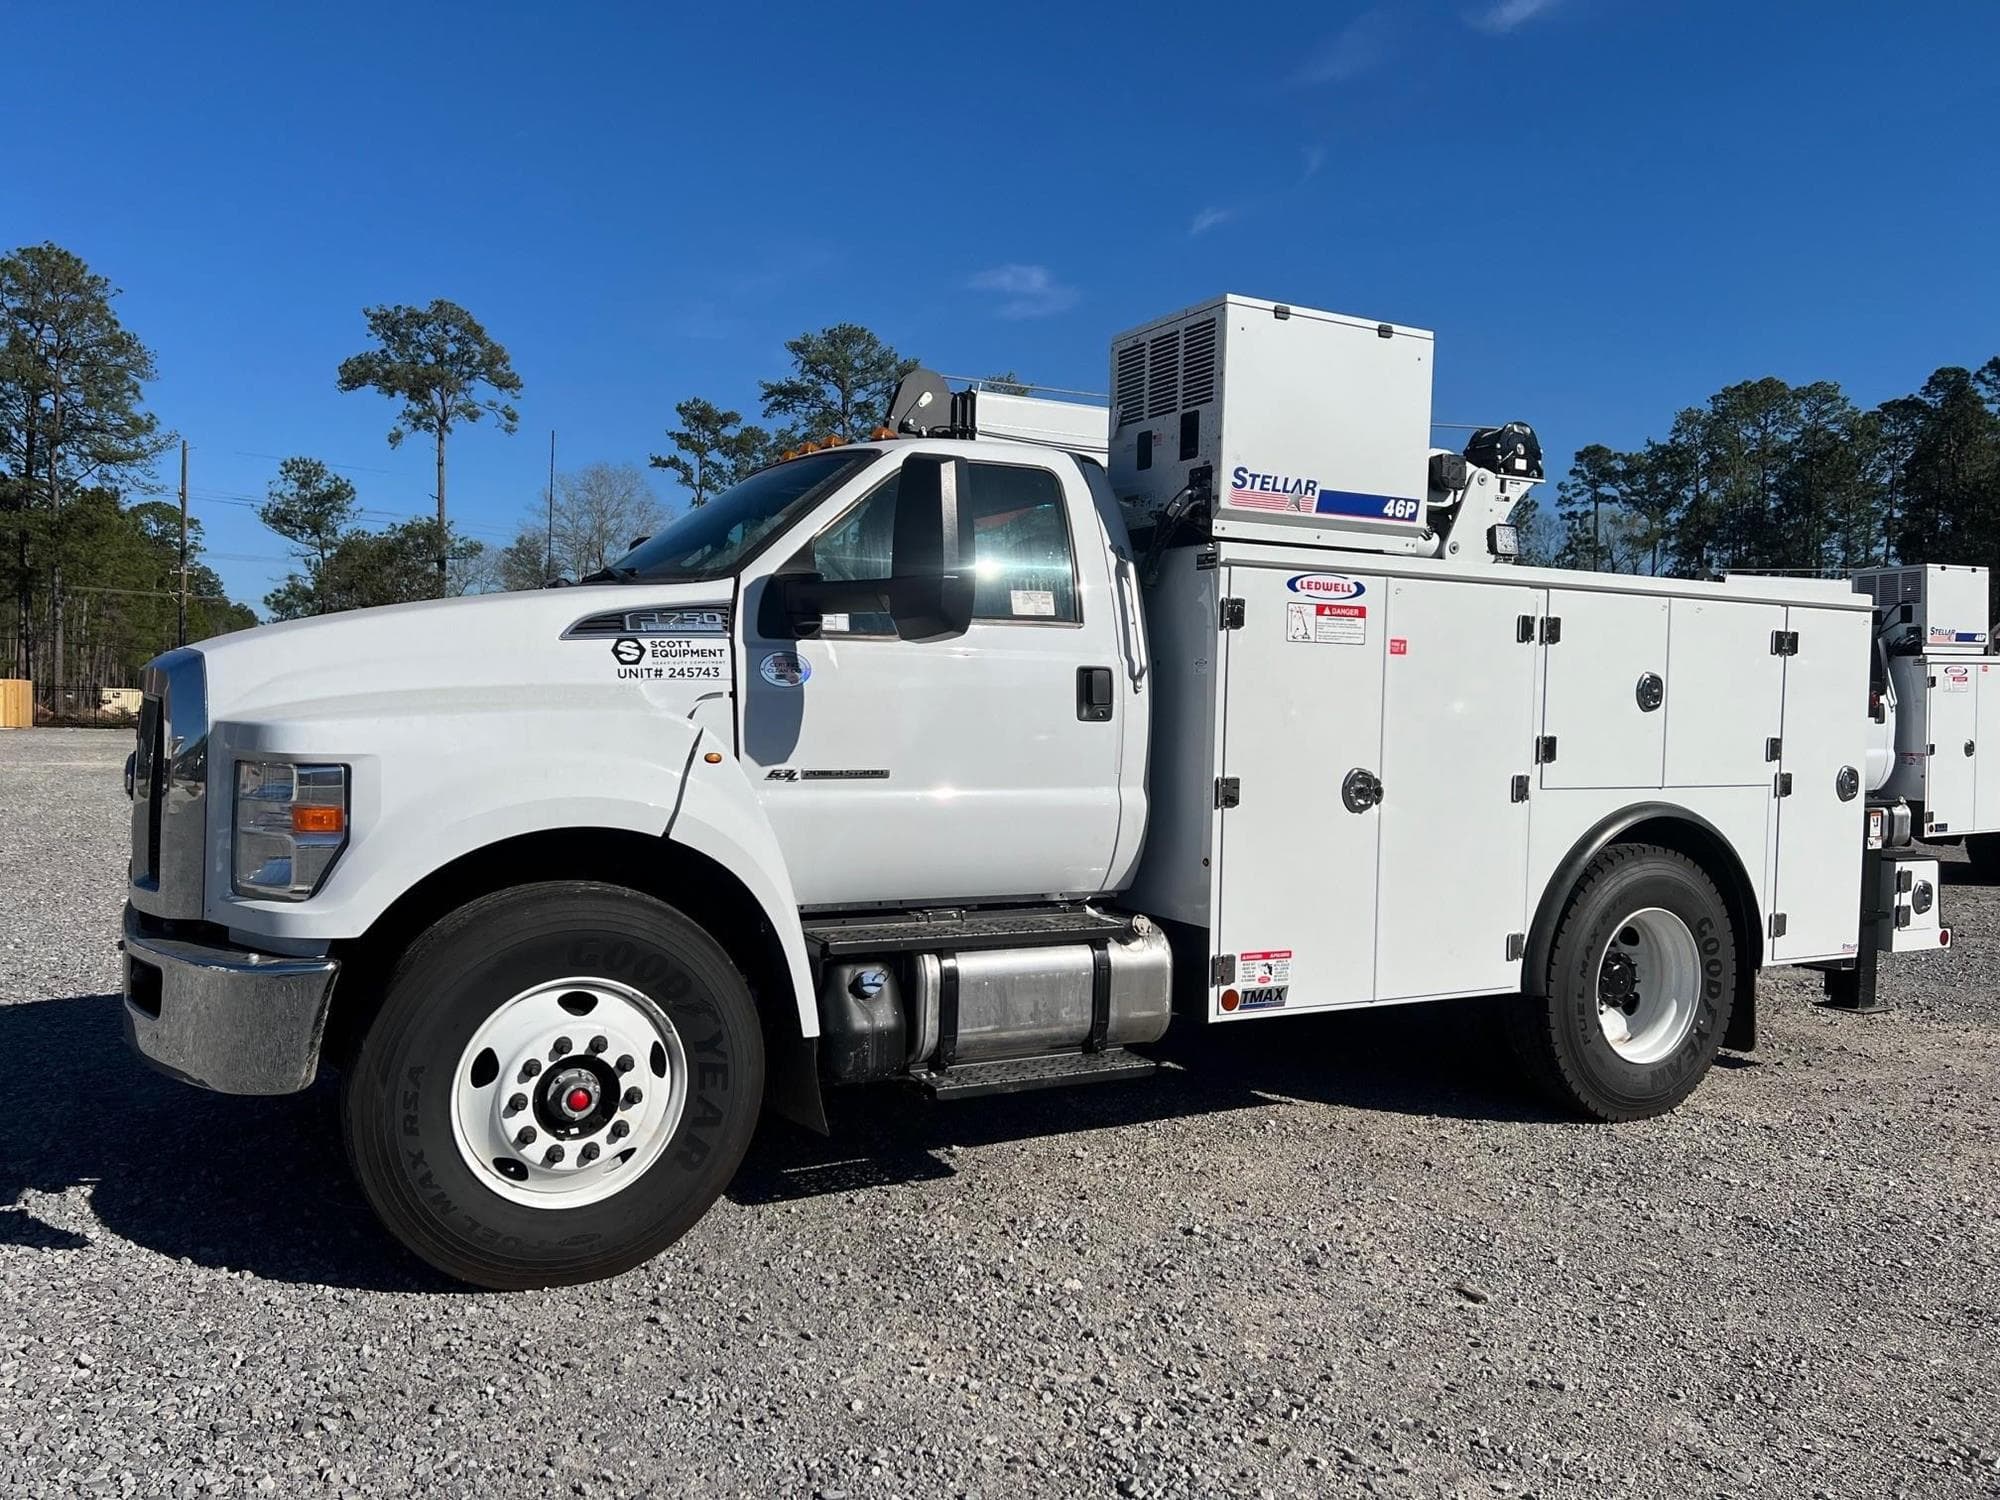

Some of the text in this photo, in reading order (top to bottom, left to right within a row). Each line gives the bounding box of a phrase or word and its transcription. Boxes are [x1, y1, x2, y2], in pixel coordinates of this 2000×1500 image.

[1231, 466, 1318, 496] STELLAR
[1383, 499, 1417, 518] 46P
[1300, 580, 1353, 593] LEDWELL
[1331, 608, 1359, 616] DANGER
[650, 640, 692, 648] SCOTT
[651, 649, 725, 658] EQUIPMENT
[617, 667, 720, 679] UNIT# 245743
[1242, 987, 1285, 1004] TMAX
[1649, 916, 1723, 1090] GOODYEAR
[402, 1065, 426, 1137] RSA
